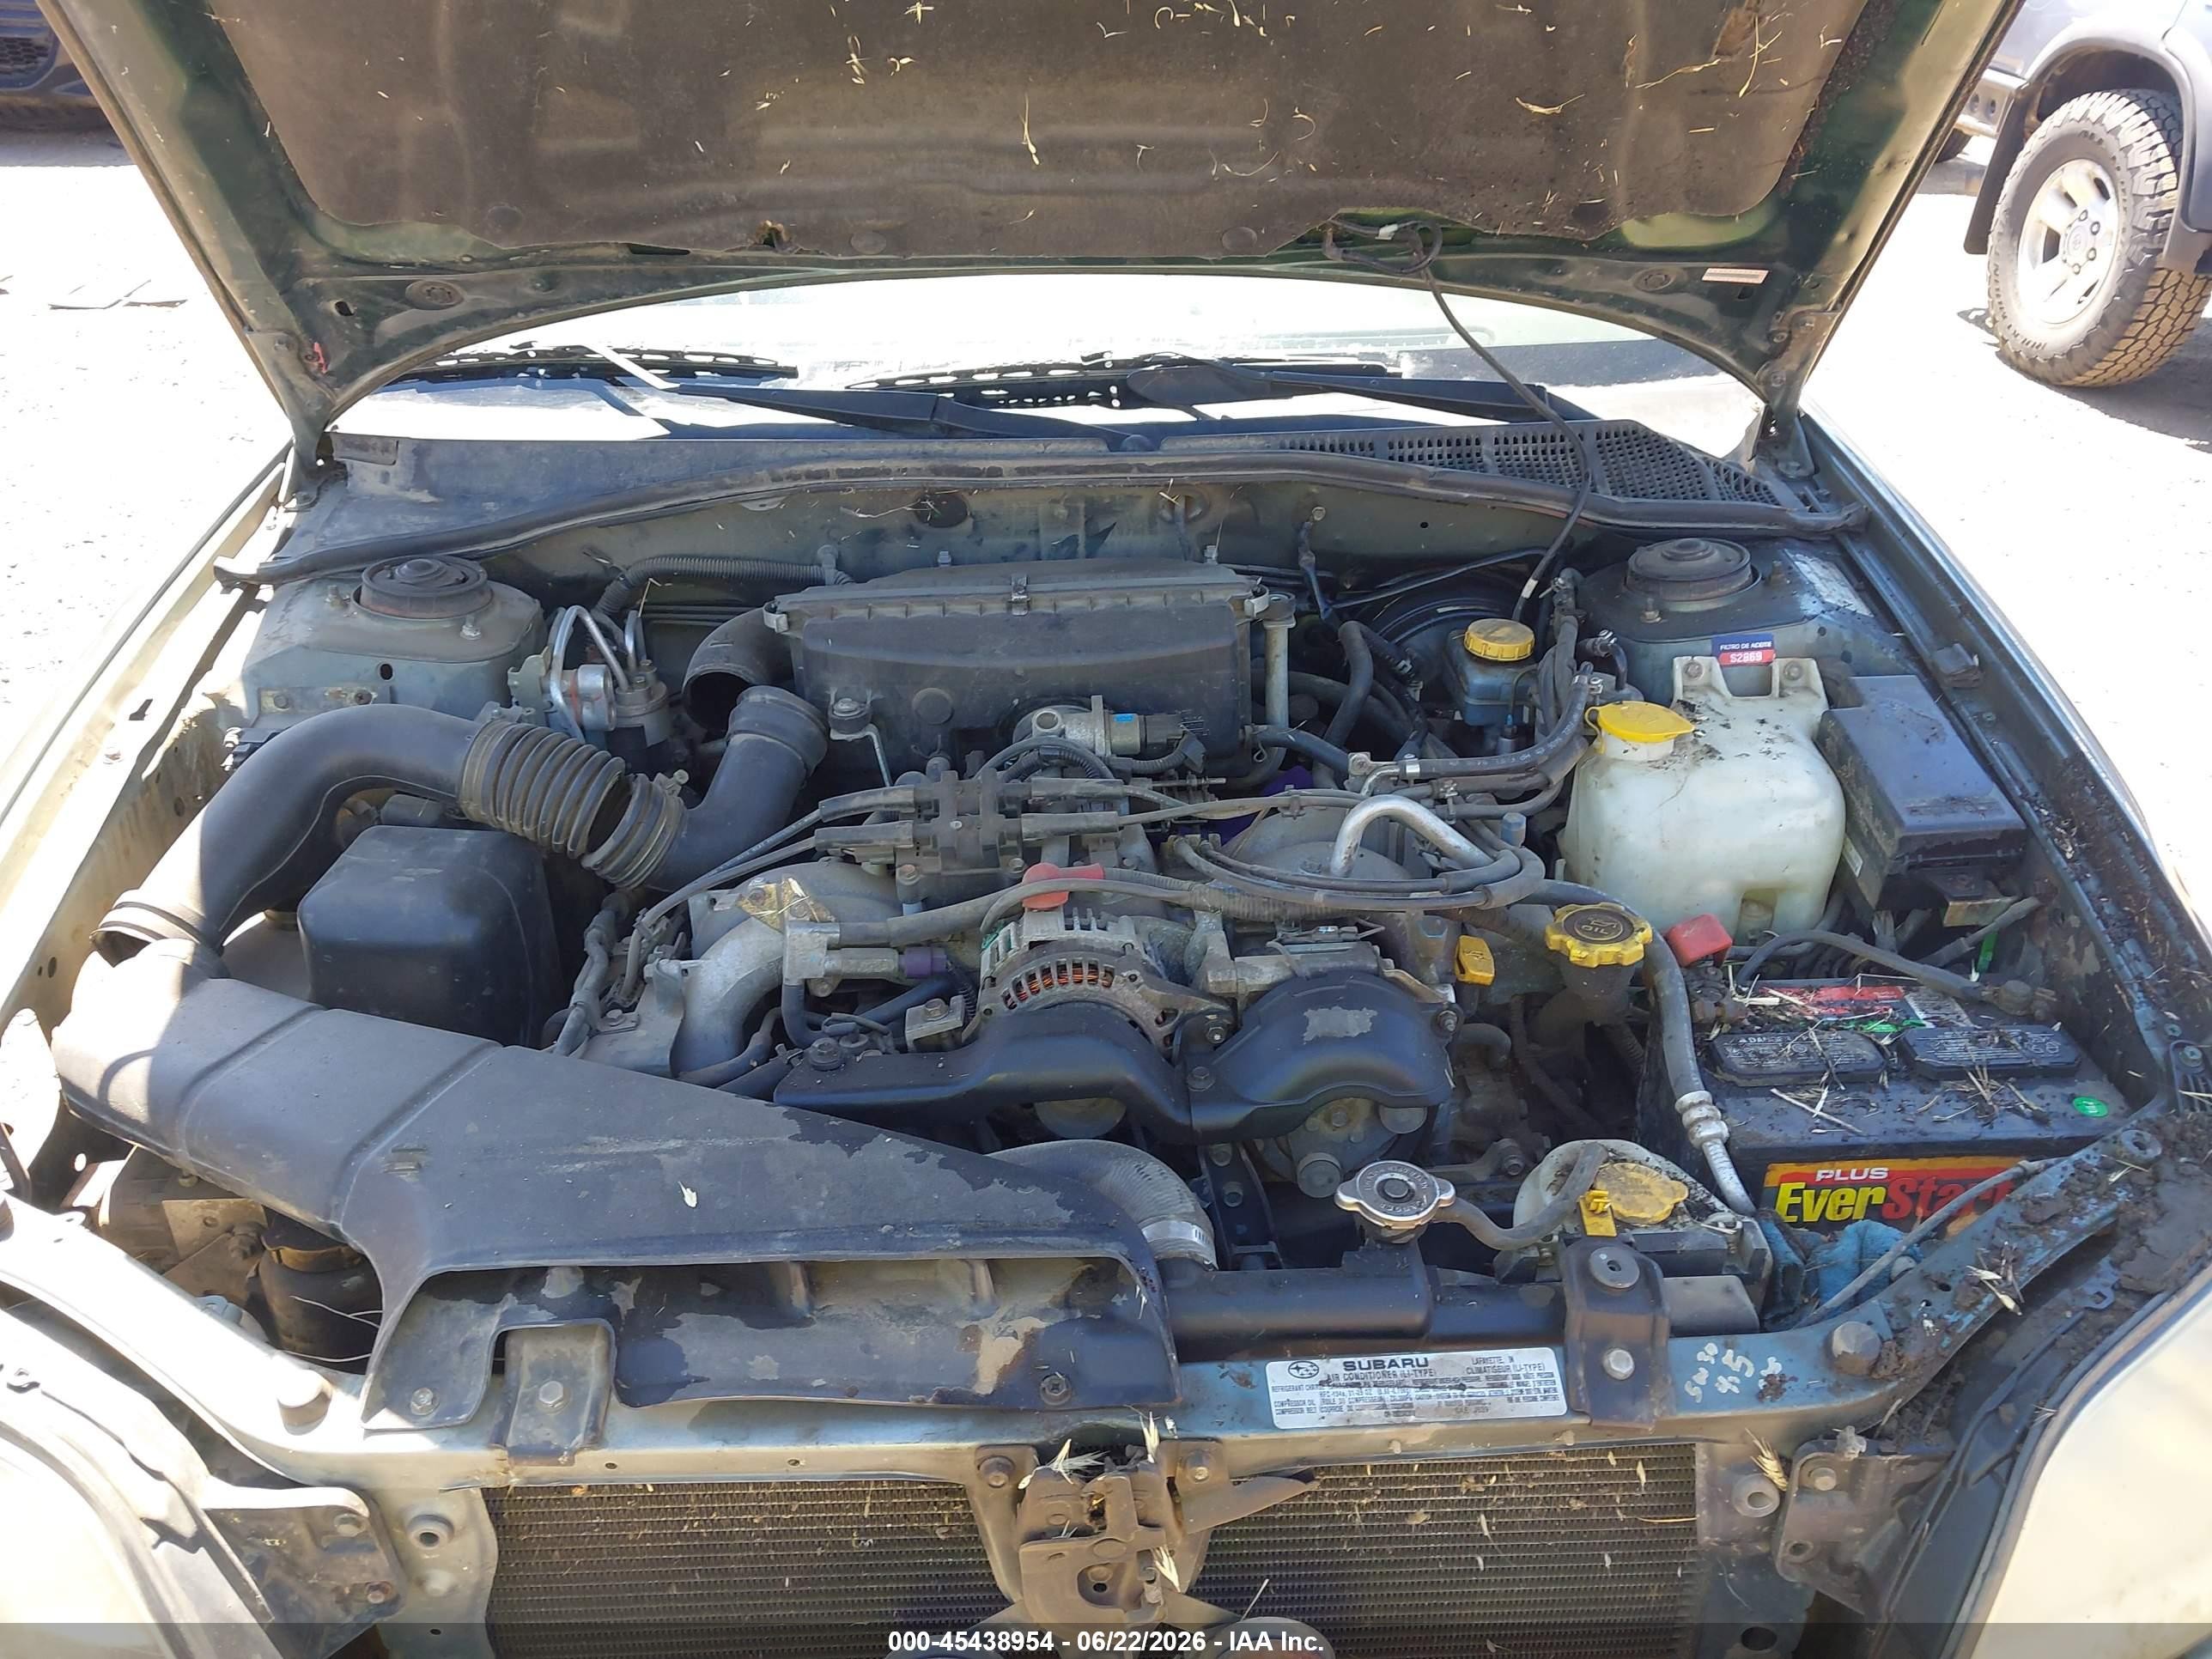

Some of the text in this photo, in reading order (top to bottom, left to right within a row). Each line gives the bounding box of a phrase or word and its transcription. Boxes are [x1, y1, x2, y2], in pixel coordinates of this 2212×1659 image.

[1581, 925, 1608, 935] OIL
[1815, 1167, 1888, 1182] PLUS
[1343, 1357, 1429, 1371] SUBARU
[1328, 1373, 1340, 1382] AIR
[1343, 1370, 1399, 1381] CONDITIONER
